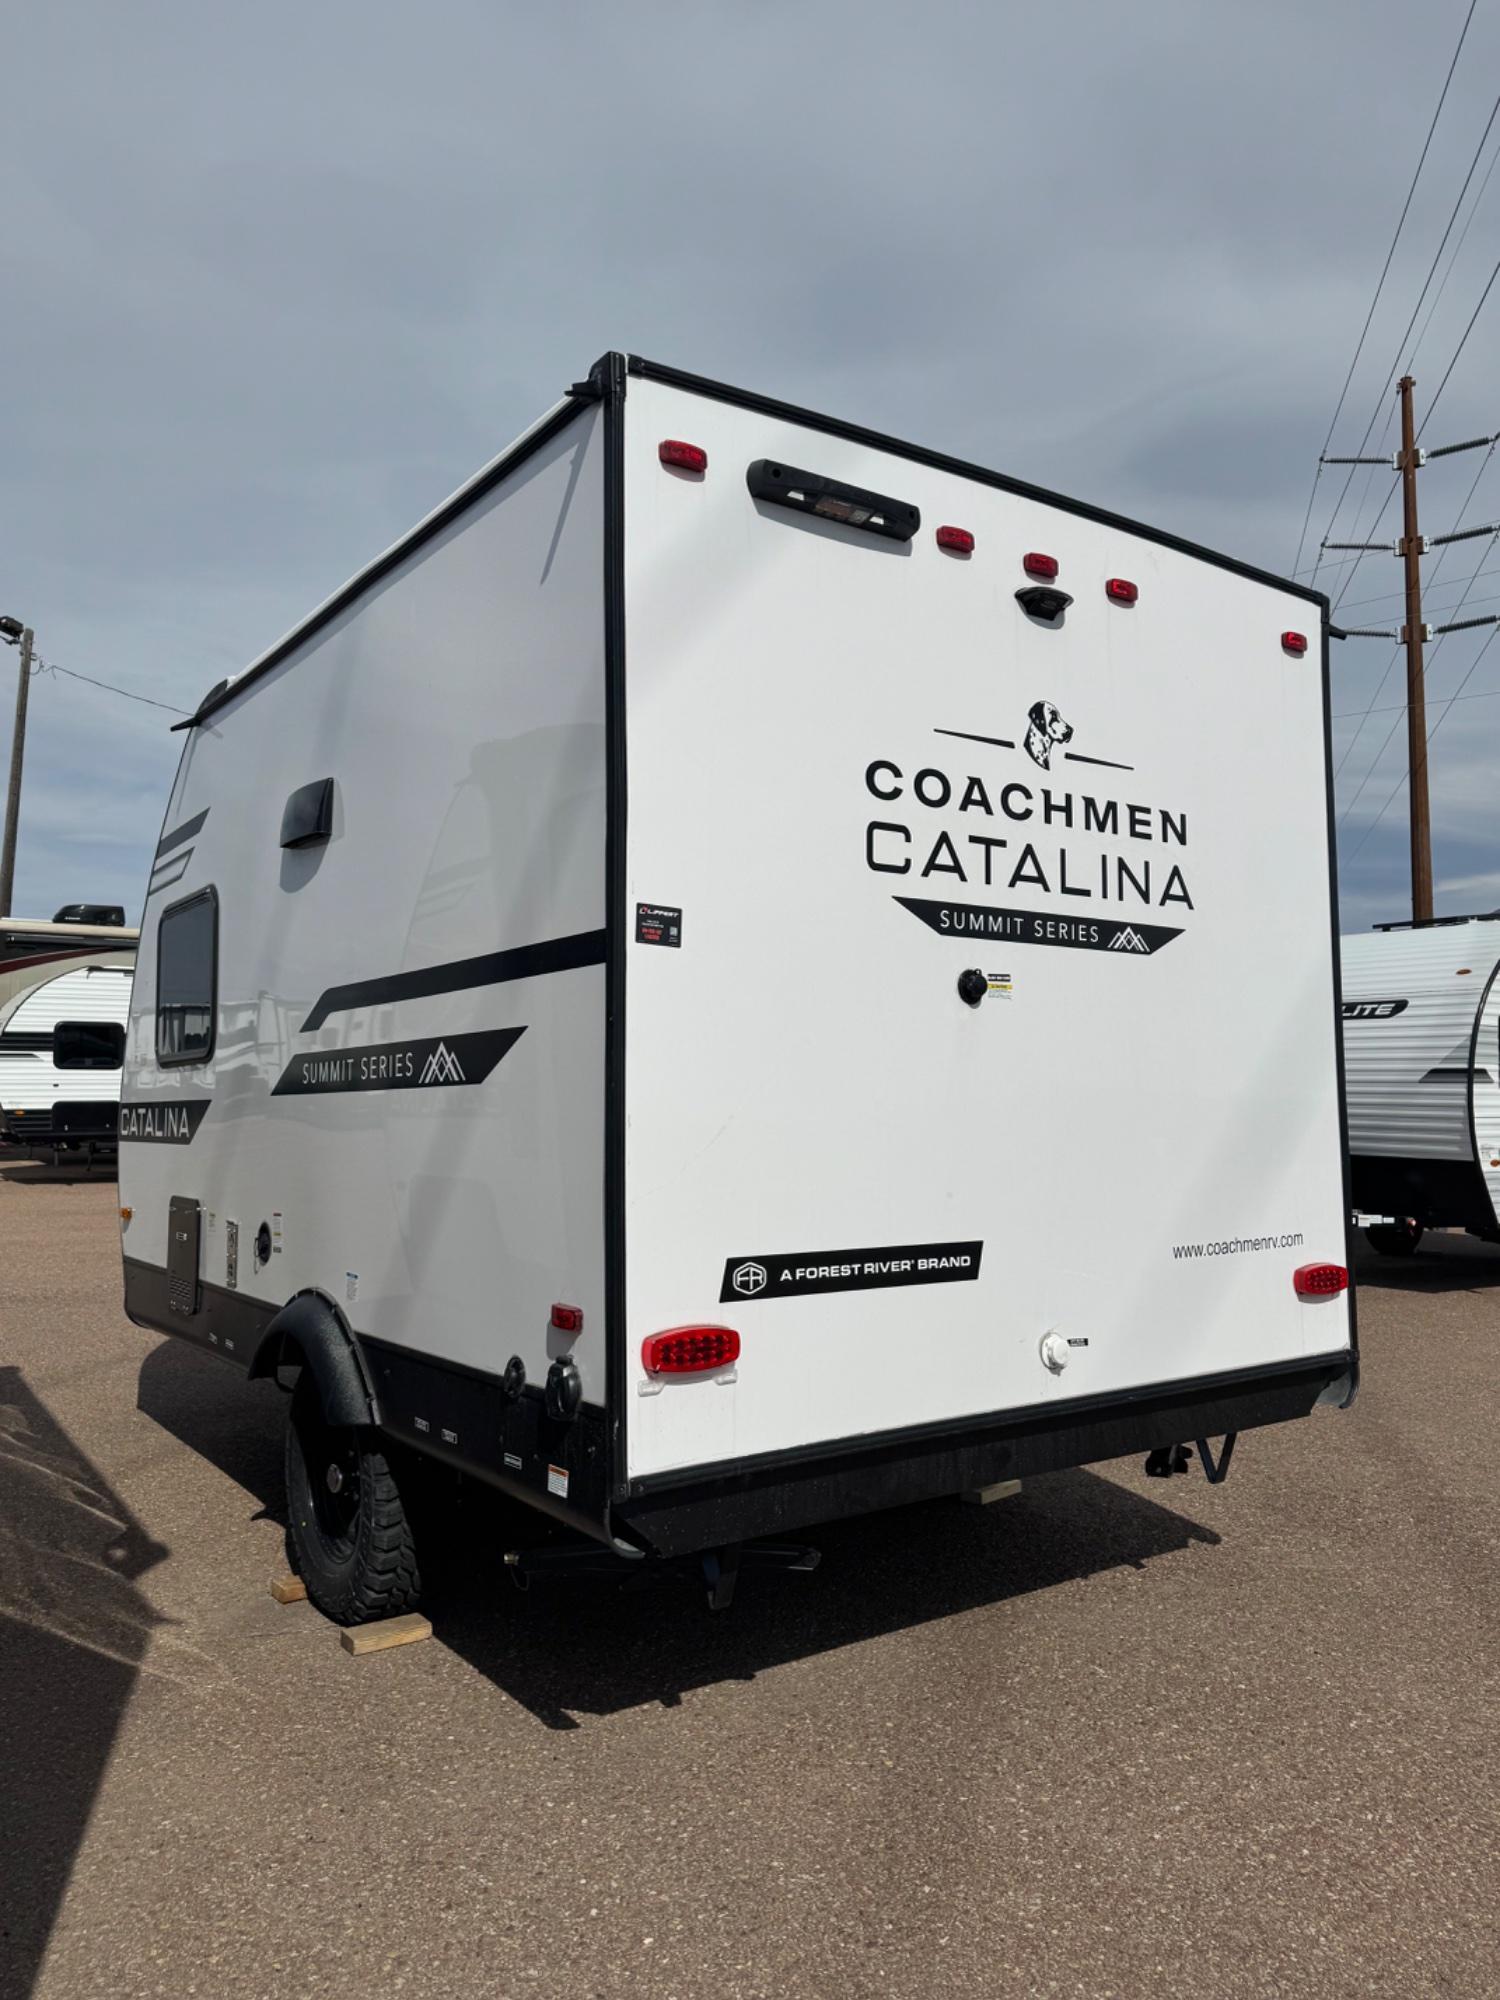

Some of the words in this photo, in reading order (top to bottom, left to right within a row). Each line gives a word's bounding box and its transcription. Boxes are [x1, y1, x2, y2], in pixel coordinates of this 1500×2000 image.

[865, 760, 1187, 846] COACHMEN
[866, 820, 1195, 910] CATALINA
[939, 909, 1024, 936] SUMMIT
[1034, 919, 1100, 943] SERIES
[302, 1058, 354, 1084] SUMMIT
[360, 1052, 413, 1080] SERIES
[121, 1106, 190, 1138] CATALINA
[1172, 1232, 1304, 1260] www.coachmenrv.com
[779, 1269, 793, 1282] A
[796, 1263, 862, 1280] FOREST
[918, 1255, 972, 1271] BRAND
